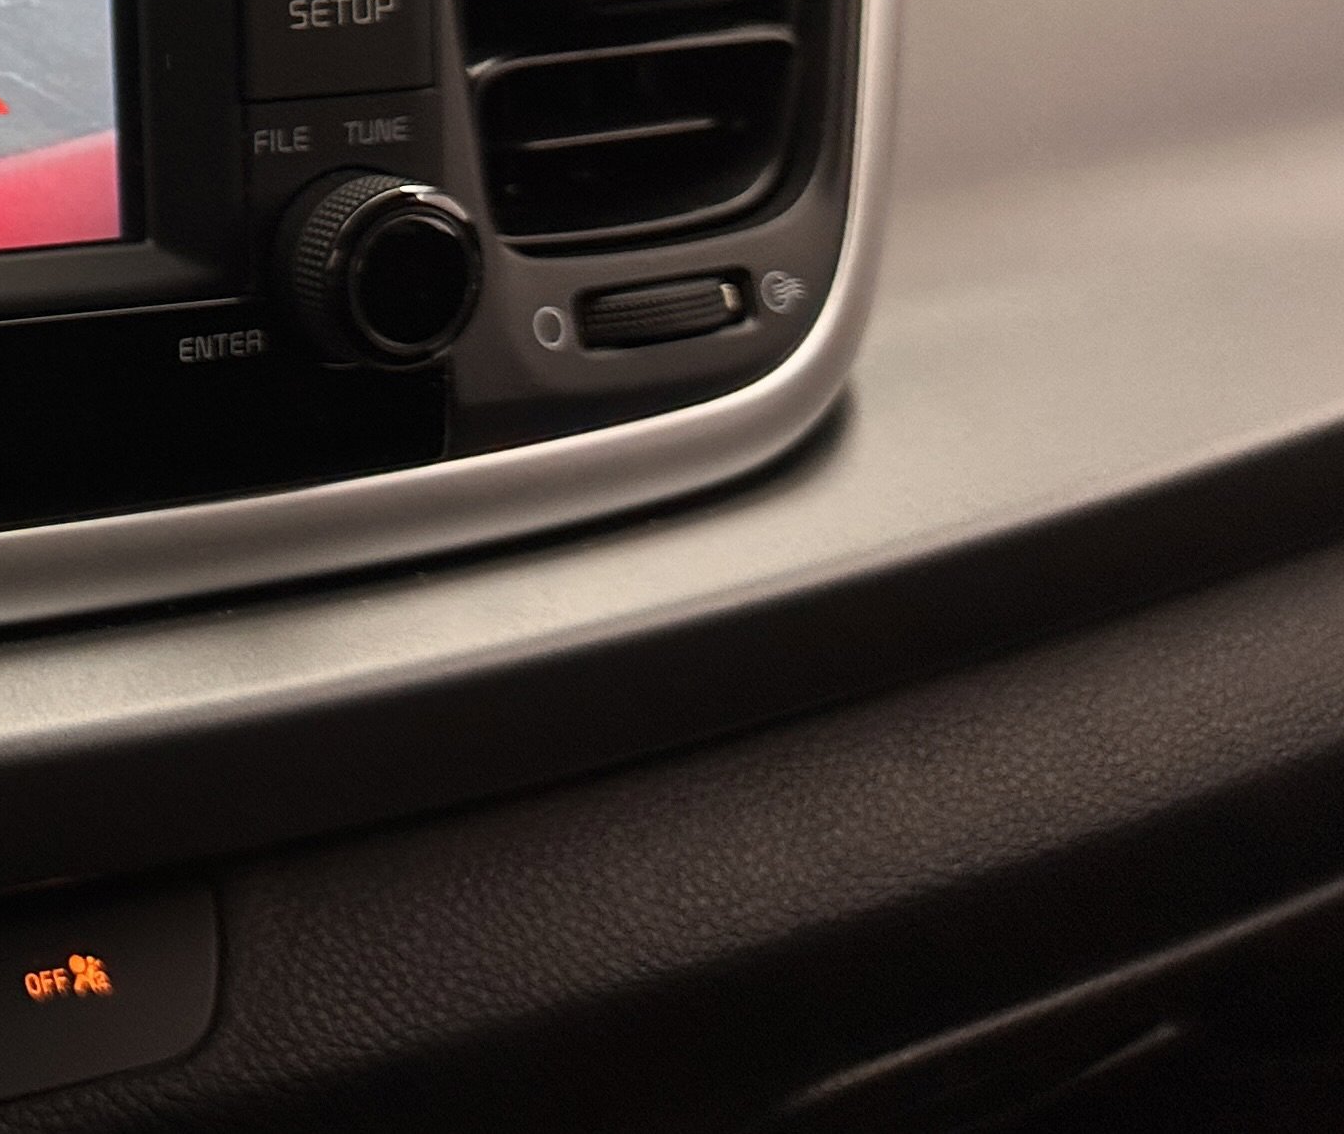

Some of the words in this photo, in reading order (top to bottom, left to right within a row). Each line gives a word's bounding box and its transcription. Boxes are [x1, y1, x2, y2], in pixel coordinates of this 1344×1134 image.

[254, 126, 310, 156] FILE
[343, 116, 411, 146] TUNE
[178, 330, 264, 362] ENTER
[24, 967, 67, 1002] OFF
